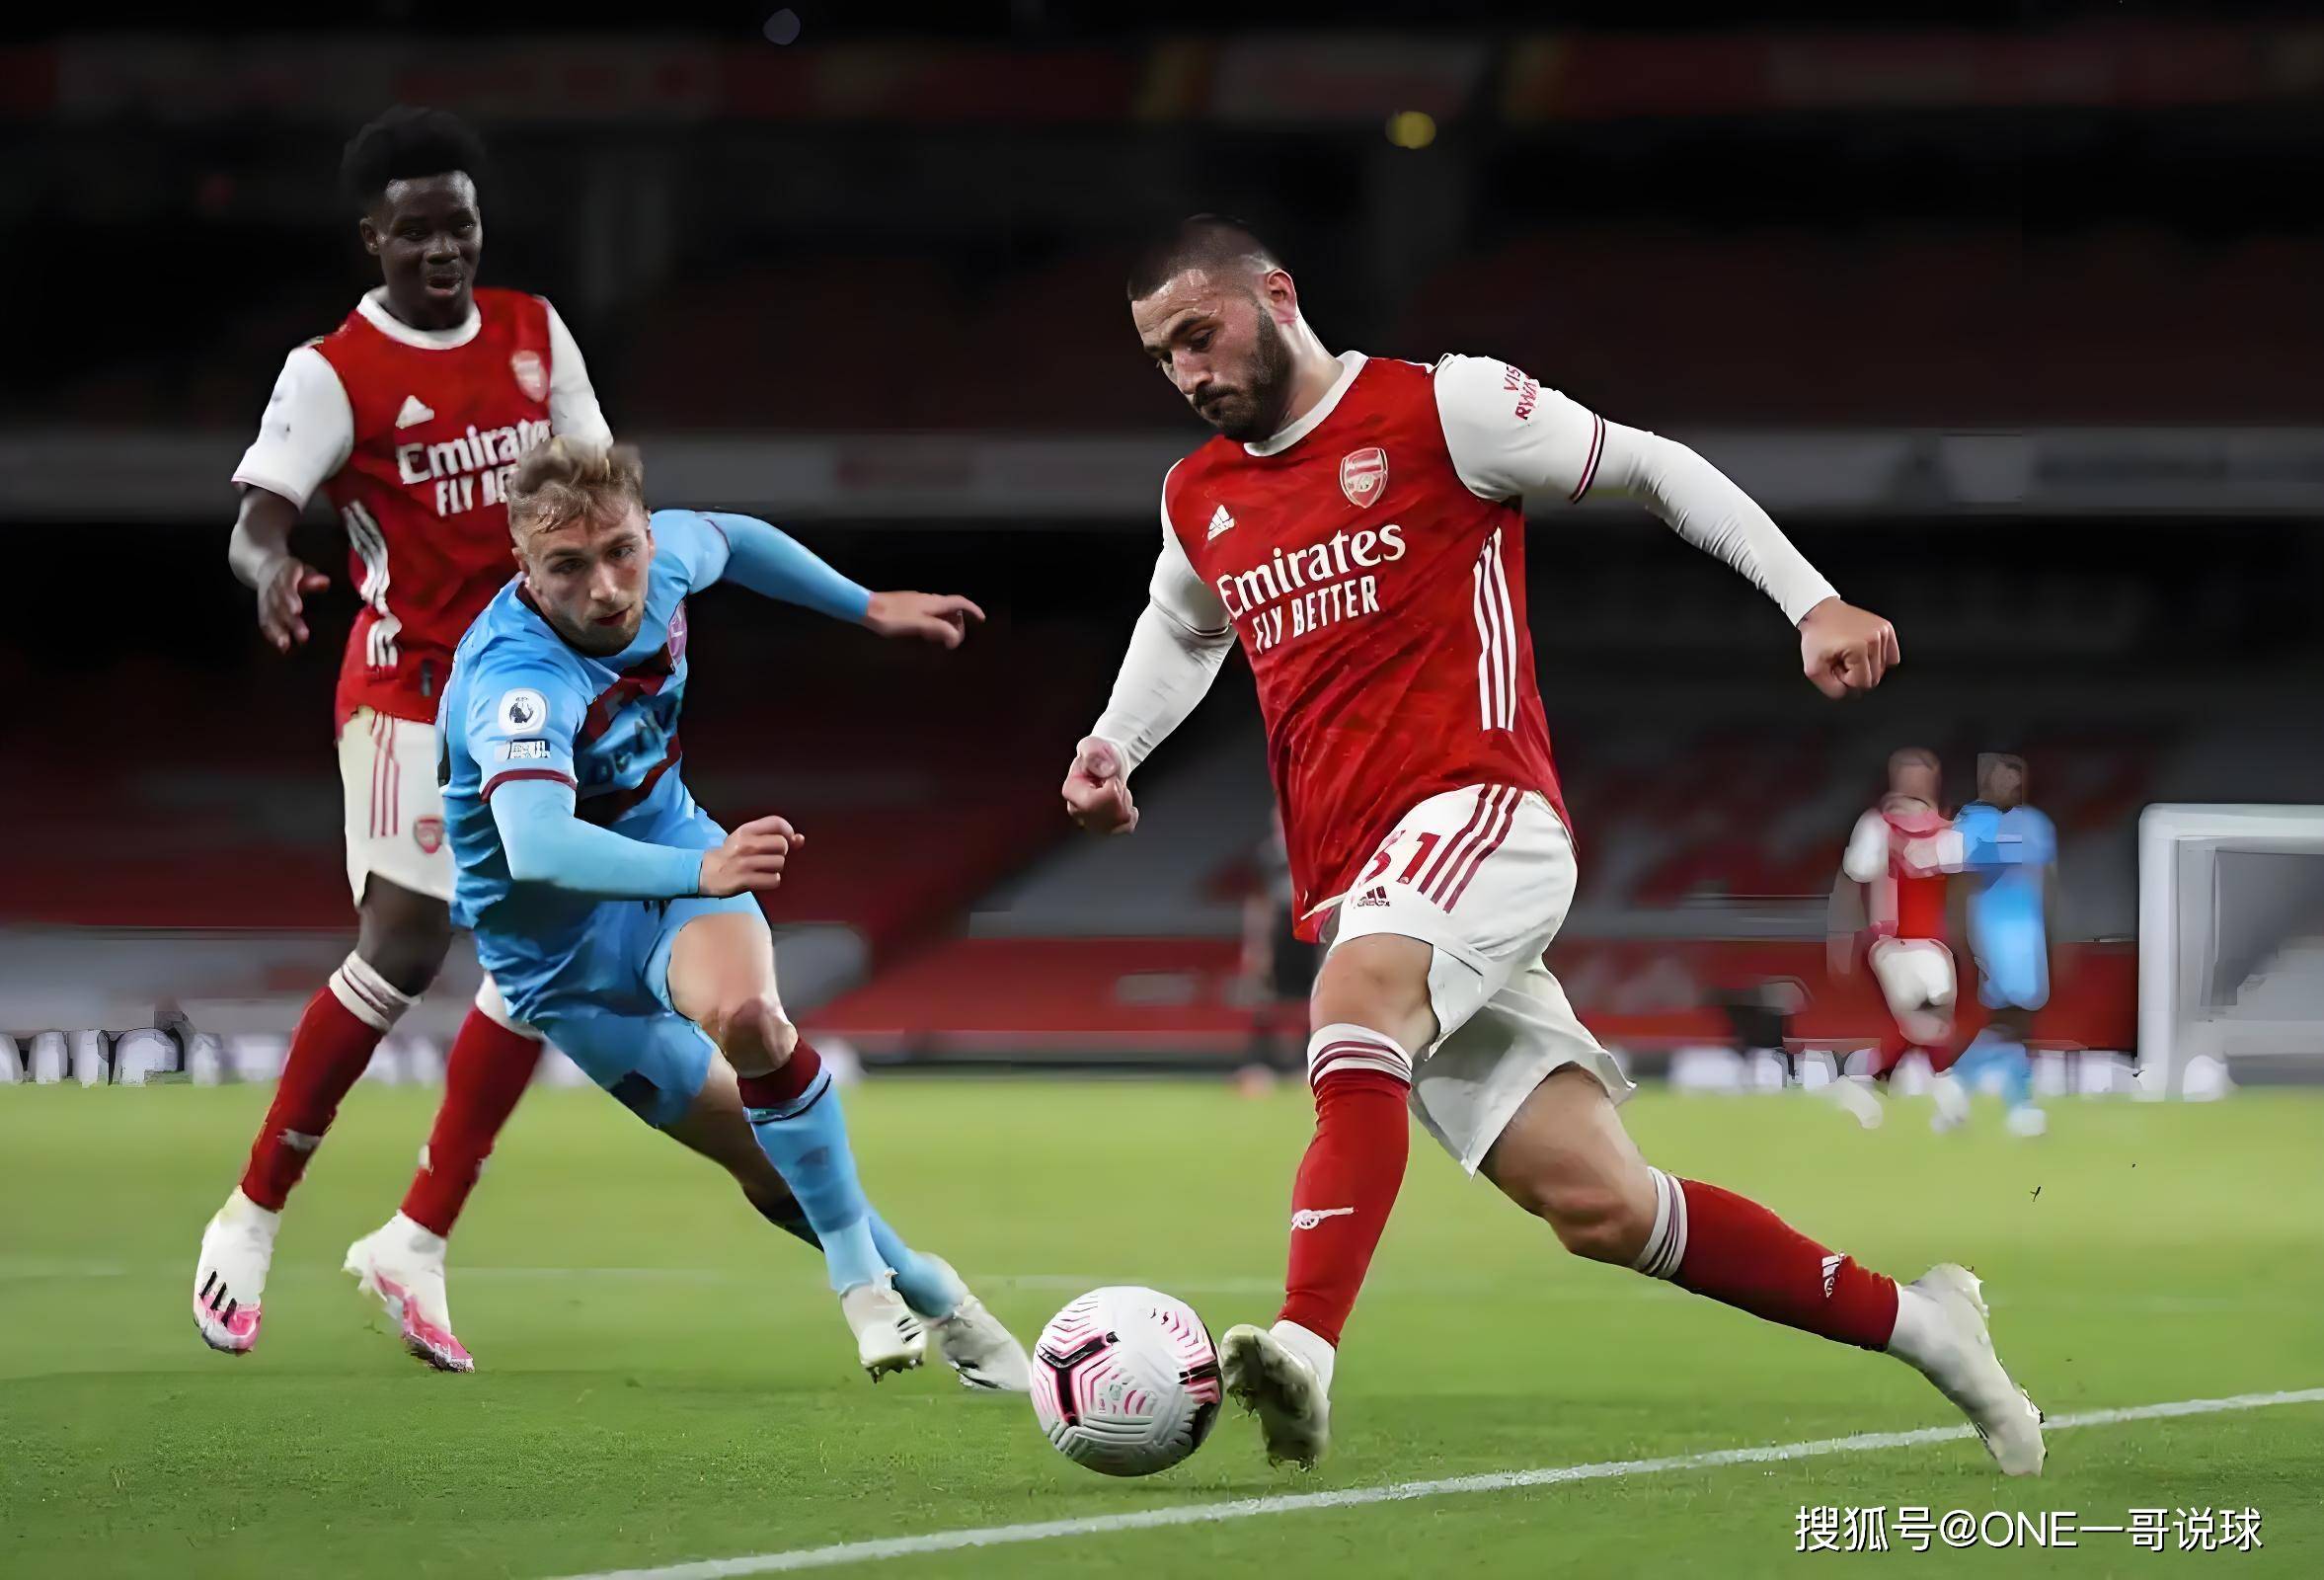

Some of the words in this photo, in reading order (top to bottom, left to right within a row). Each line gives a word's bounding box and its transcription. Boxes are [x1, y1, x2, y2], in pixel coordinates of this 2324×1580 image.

[1215, 523, 1407, 621] Emirates
[1252, 604, 1283, 655] FLY
[1290, 575, 1380, 639] BETTER
